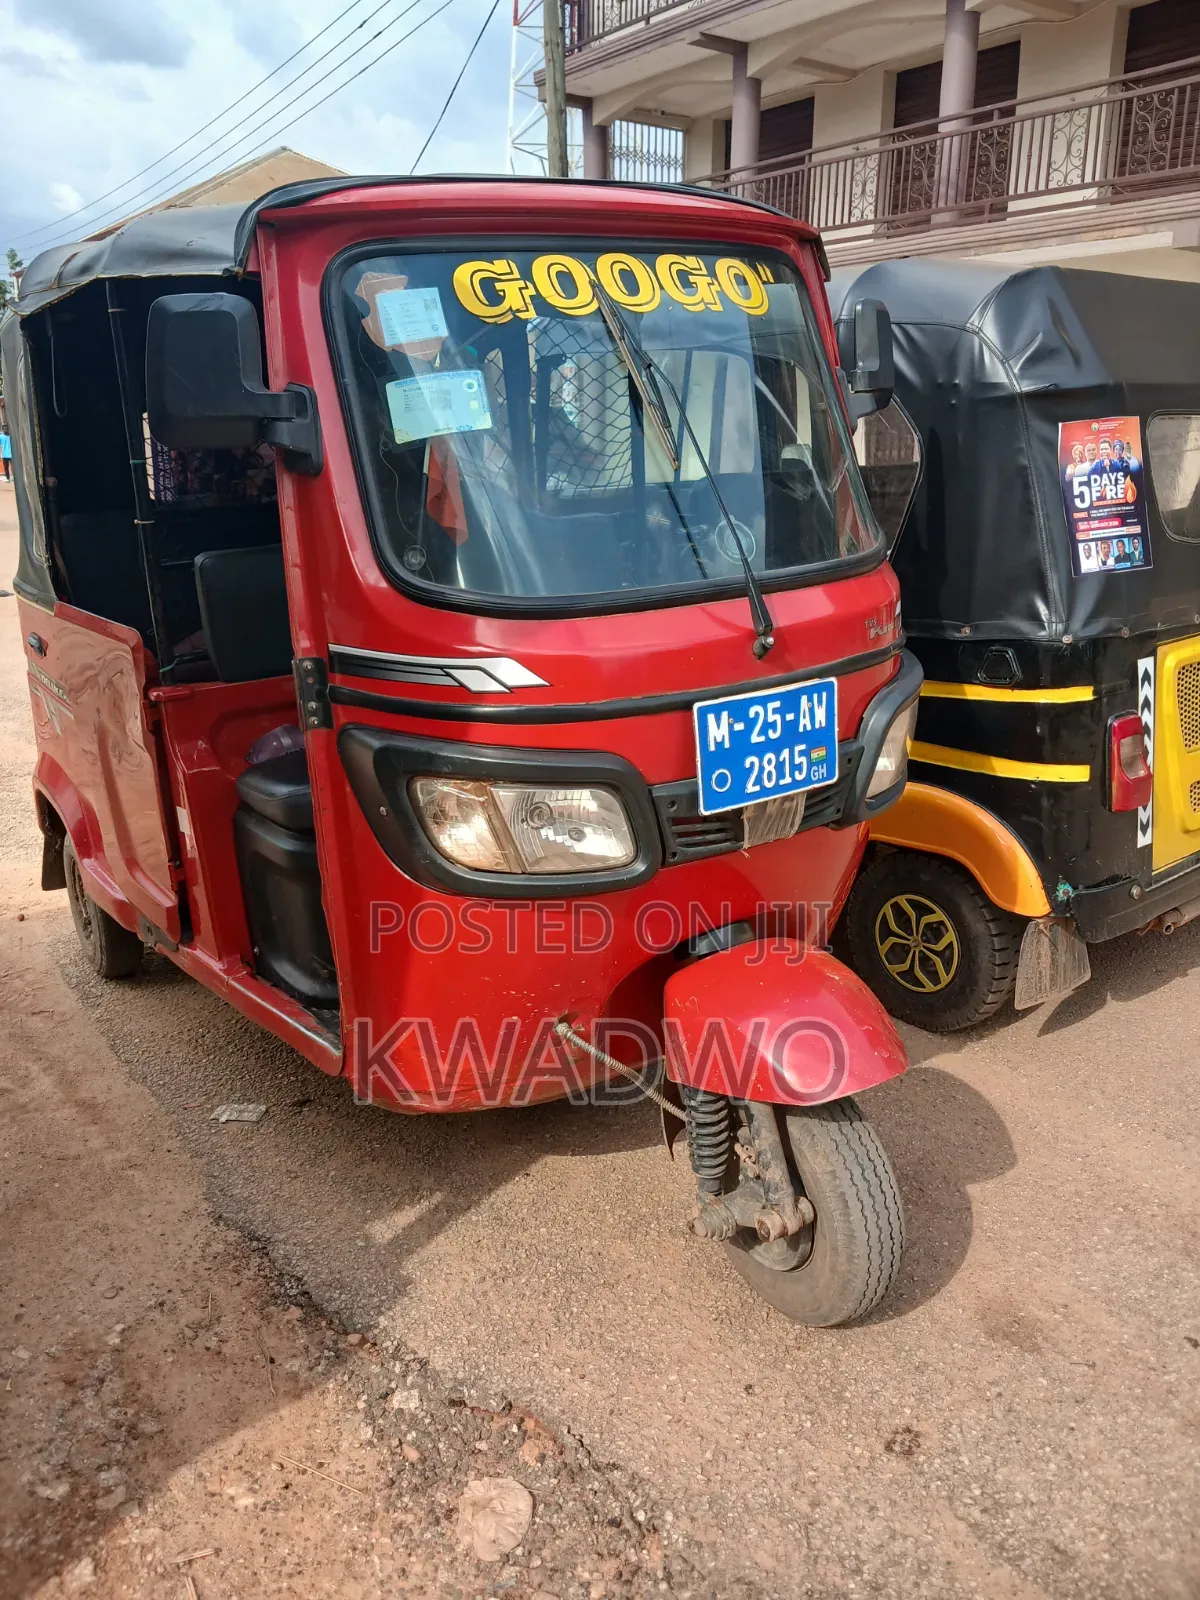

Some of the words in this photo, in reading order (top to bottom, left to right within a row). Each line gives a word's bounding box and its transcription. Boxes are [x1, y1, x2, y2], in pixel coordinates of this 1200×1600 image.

[1072, 475, 1091, 509] 5
[1090, 471, 1125, 487] DAYS
[744, 744, 807, 794] 2815
[810, 762, 827, 781] GH
